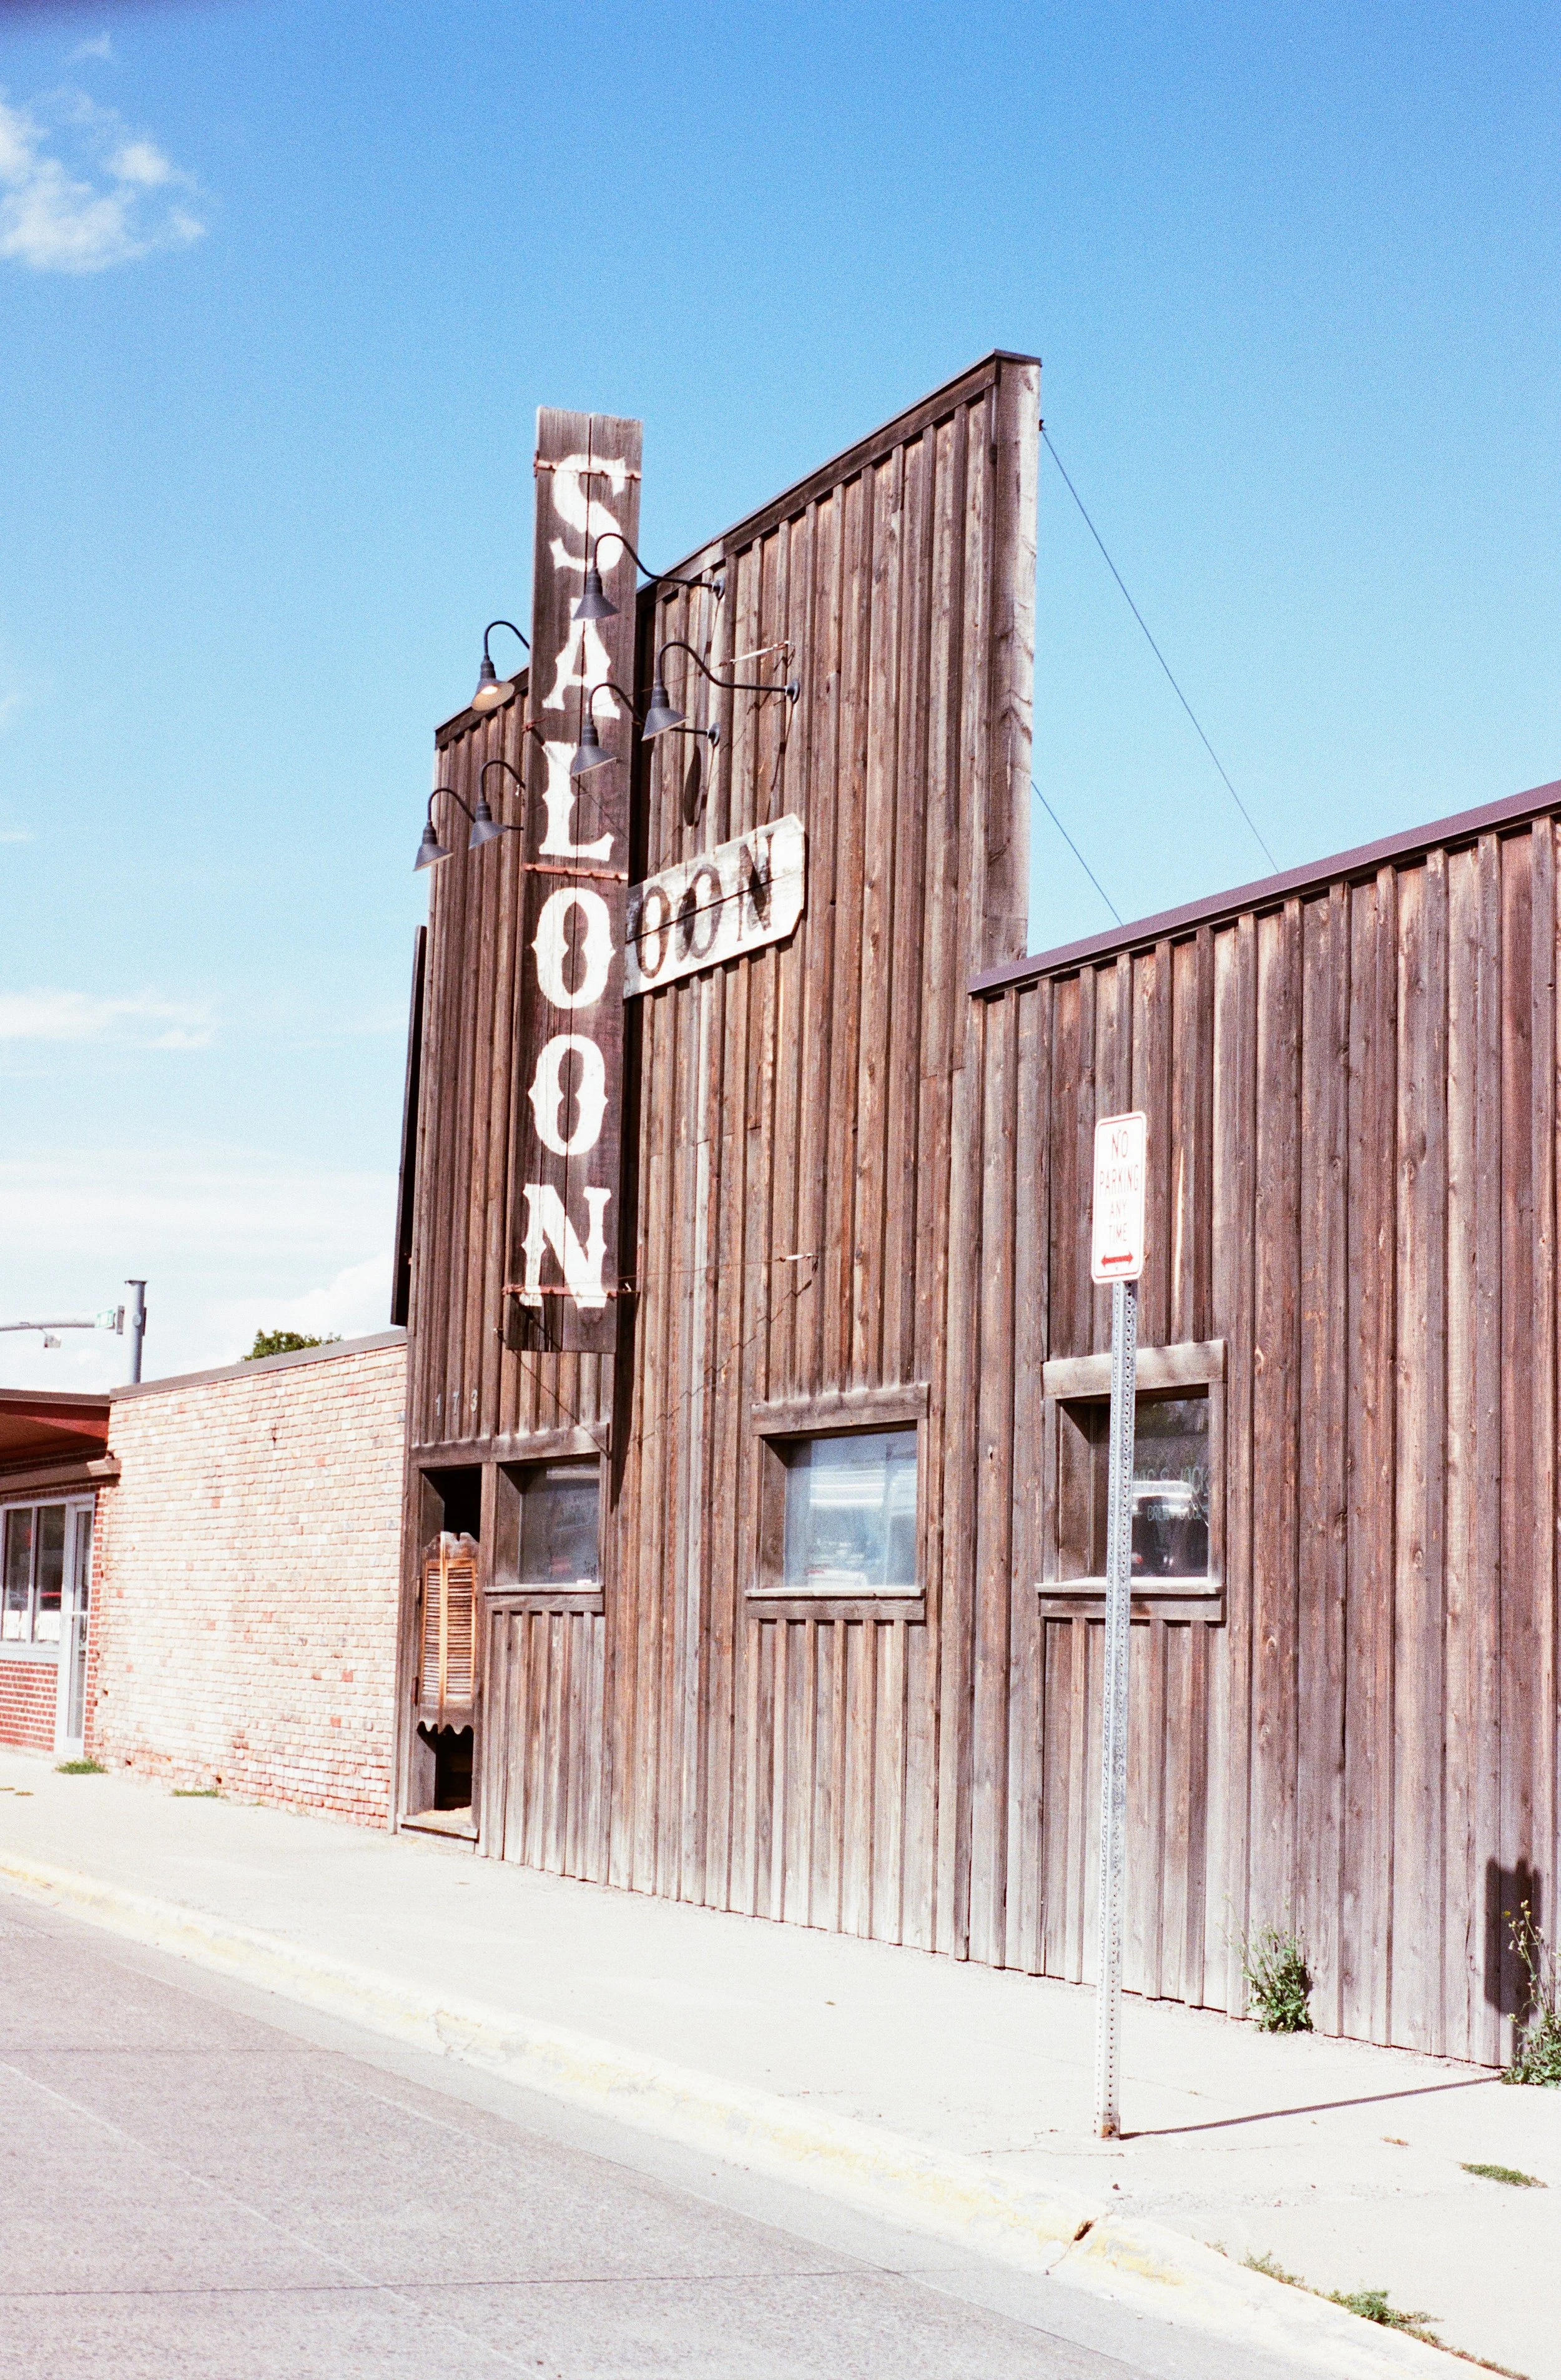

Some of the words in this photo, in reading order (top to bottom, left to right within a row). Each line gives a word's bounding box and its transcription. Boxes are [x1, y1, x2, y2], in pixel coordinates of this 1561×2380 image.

[520, 453, 627, 1310] SALOON
[1111, 1130, 1128, 1160] NO
[1098, 1164, 1139, 1196] PARKING
[1109, 1198, 1128, 1218] ANY
[1108, 1222, 1128, 1244] TIME
